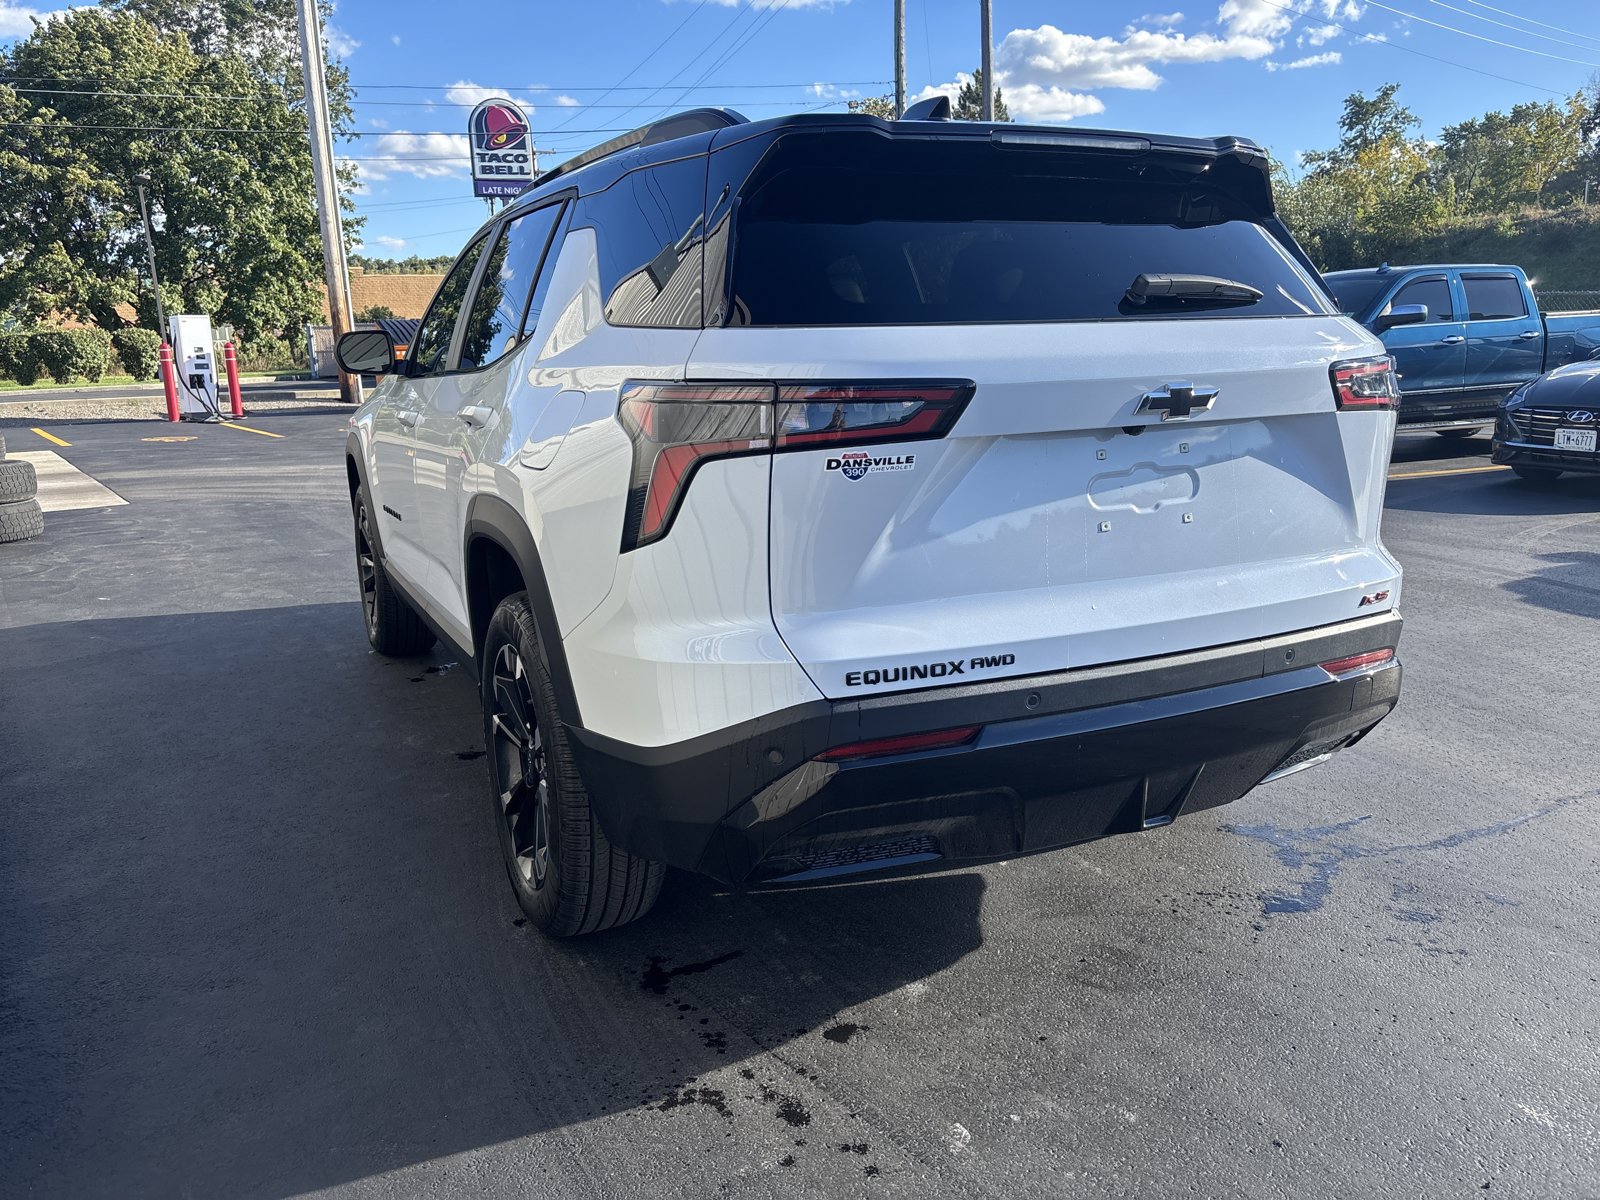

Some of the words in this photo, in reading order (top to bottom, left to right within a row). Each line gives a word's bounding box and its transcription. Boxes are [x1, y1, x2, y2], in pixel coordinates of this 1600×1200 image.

[476, 153, 529, 163] TACO
[481, 165, 530, 175] BELL
[826, 455, 915, 470] DANSVILLE
[846, 468, 865, 477] 390
[870, 464, 912, 472] CHEVROLET
[845, 660, 965, 686] EQUINOX
[970, 653, 1016, 670] AWD
